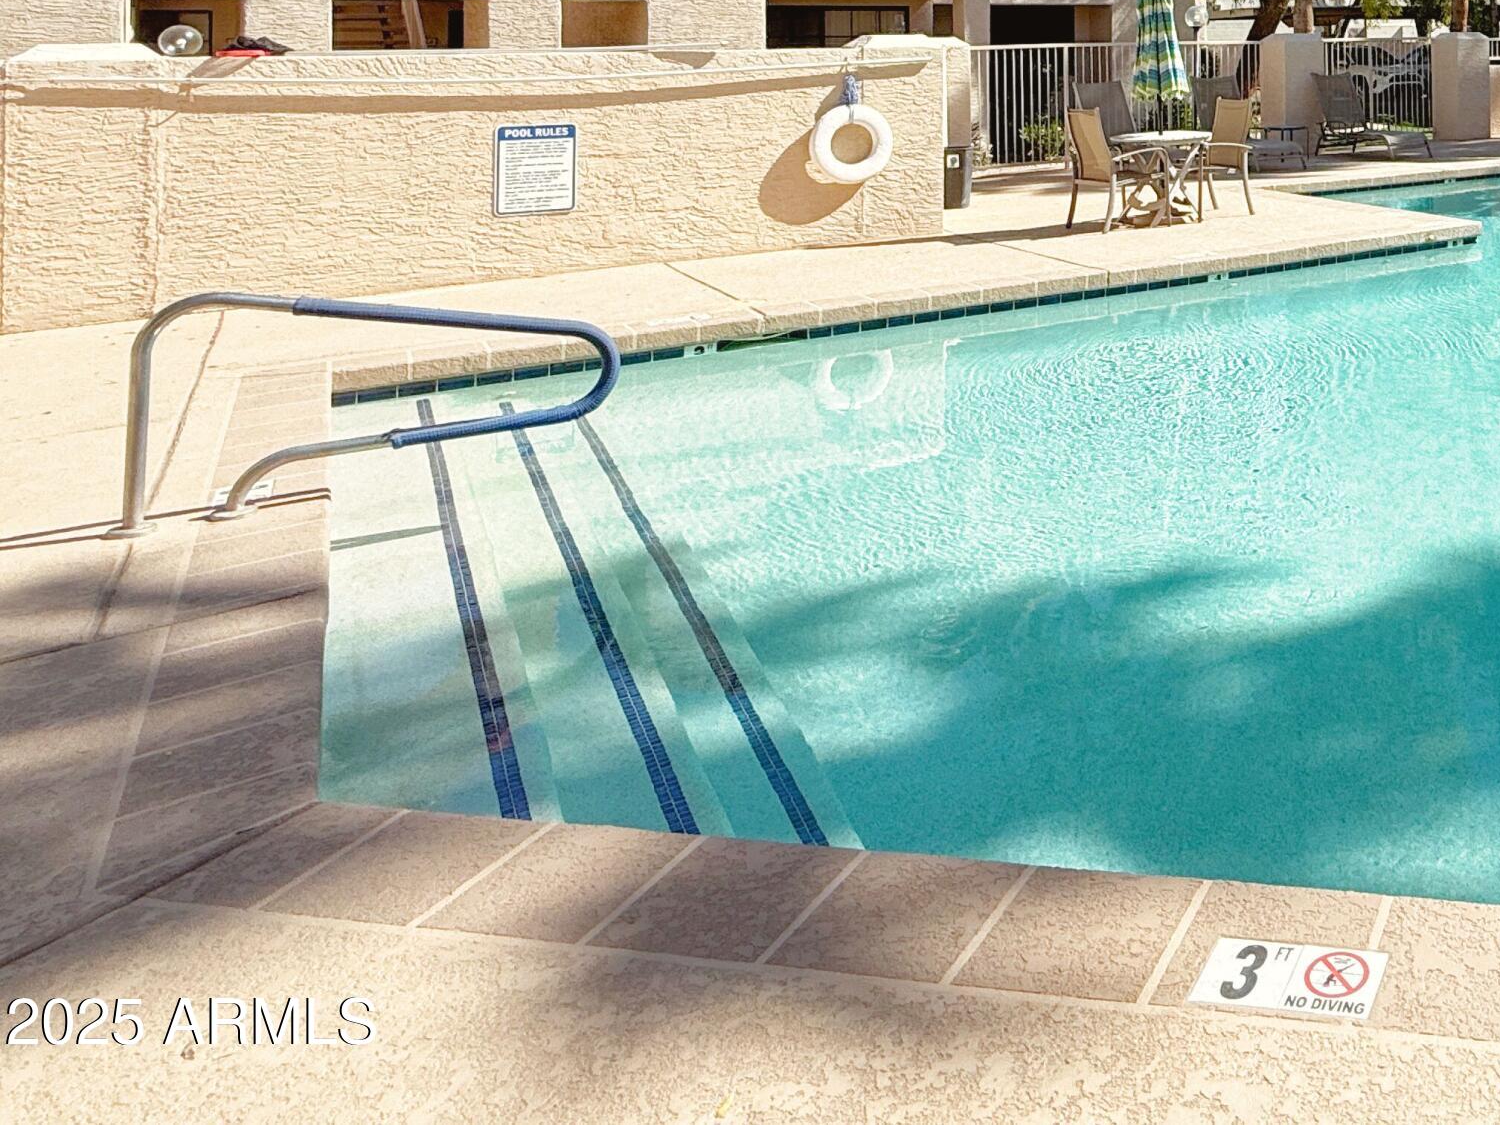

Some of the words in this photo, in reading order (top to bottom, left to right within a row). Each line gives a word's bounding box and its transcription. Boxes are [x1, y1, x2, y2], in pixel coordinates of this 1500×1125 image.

[504, 129, 533, 138] POOL
[535, 127, 569, 137] RULES
[1219, 944, 1268, 1000] 3
[1274, 946, 1294, 962] FT
[1284, 995, 1307, 1008] NO
[1311, 998, 1365, 1015] DIVING
